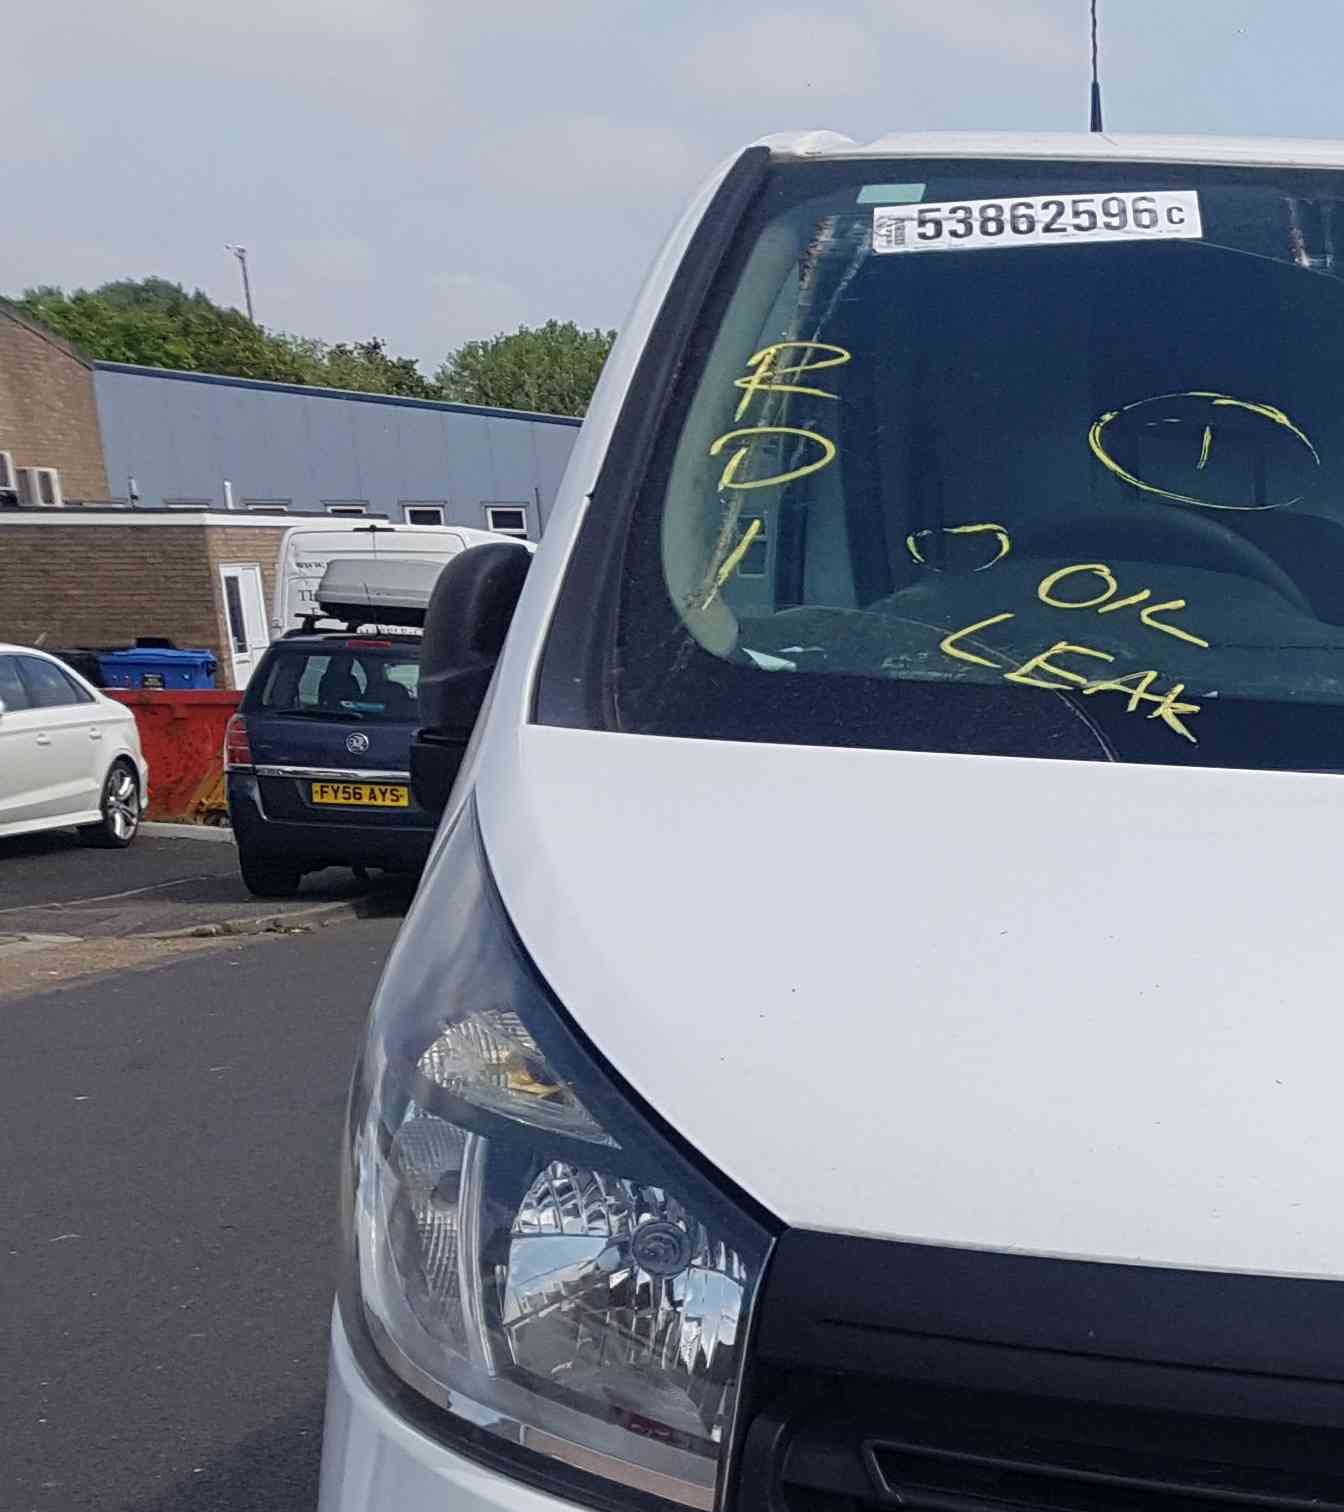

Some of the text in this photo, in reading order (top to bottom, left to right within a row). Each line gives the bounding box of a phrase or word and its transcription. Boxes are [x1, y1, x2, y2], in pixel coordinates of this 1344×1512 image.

[917, 196, 1158, 241] 53862596
[1038, 563, 1210, 648] OIL
[940, 613, 1202, 745] LEAK
[319, 785, 400, 803] FY56 AYS
